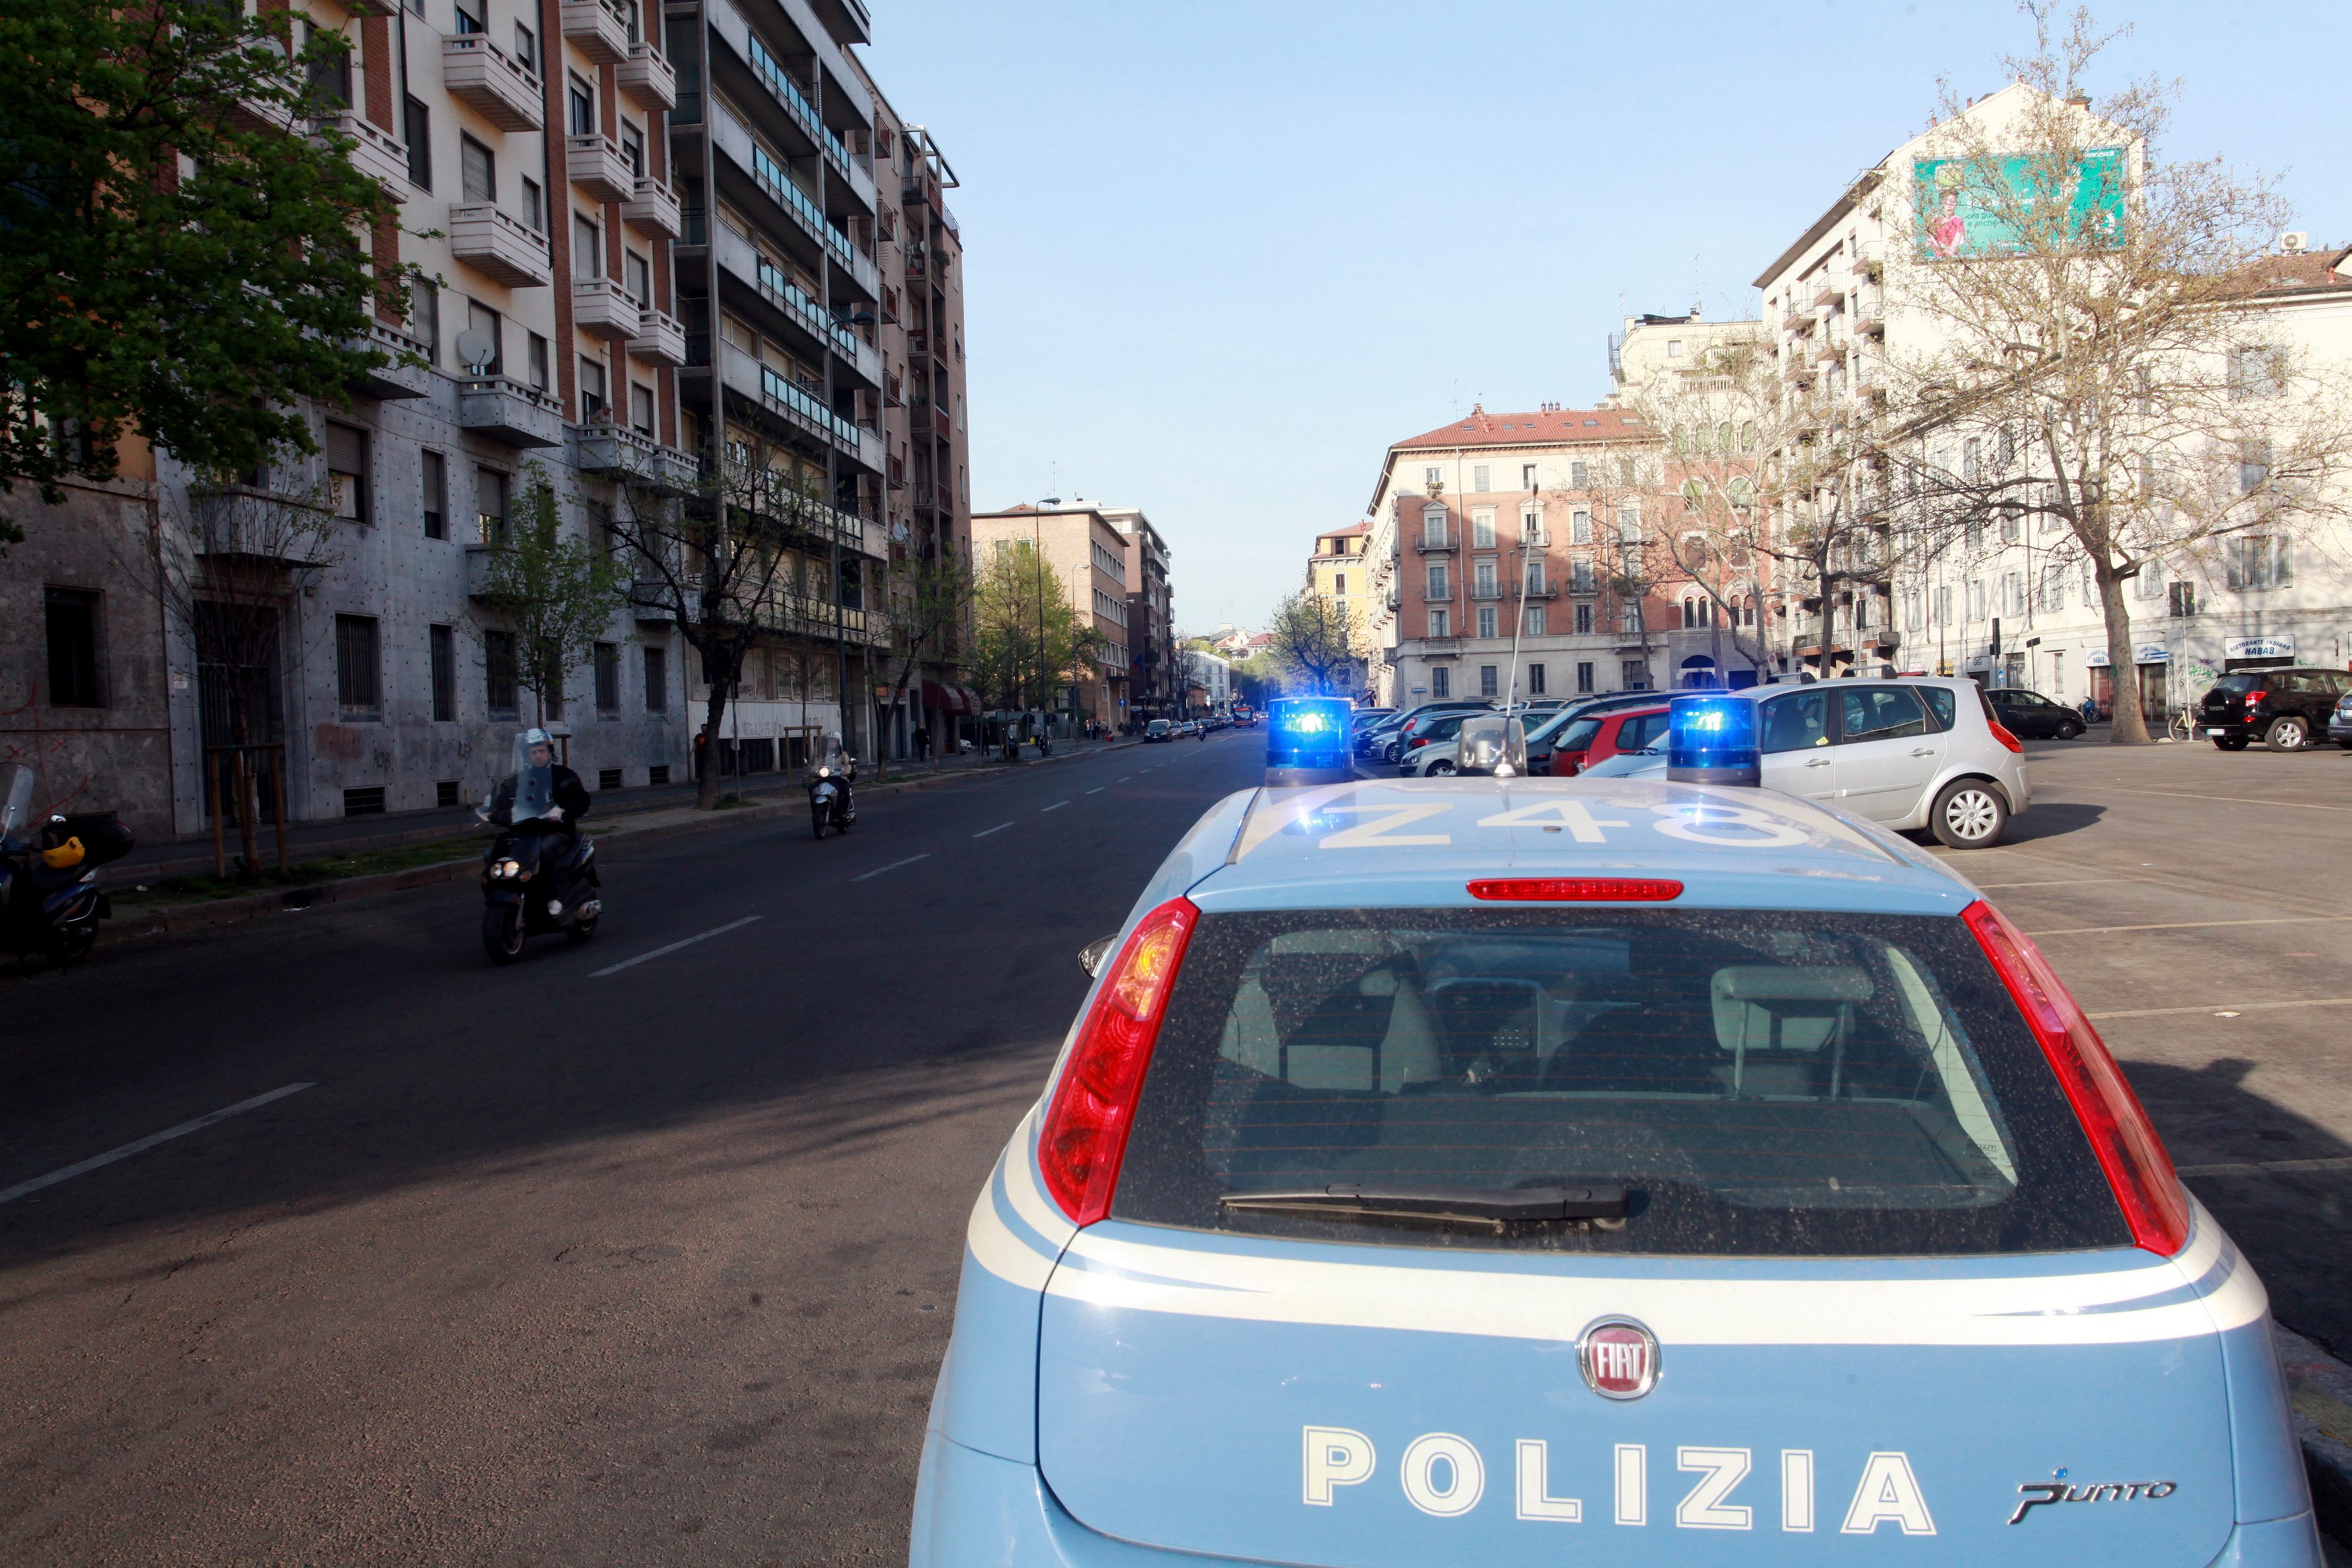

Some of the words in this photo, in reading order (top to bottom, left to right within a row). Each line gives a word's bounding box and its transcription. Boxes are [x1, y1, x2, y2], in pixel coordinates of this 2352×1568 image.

[2229, 640, 2263, 652] RISTORANTE
[2265, 640, 2290, 650] INDIANO
[2244, 647, 2275, 655] NABAB
[1597, 1342, 1642, 1380] FIAT
[1303, 1425, 1937, 1536] POLIZIA
